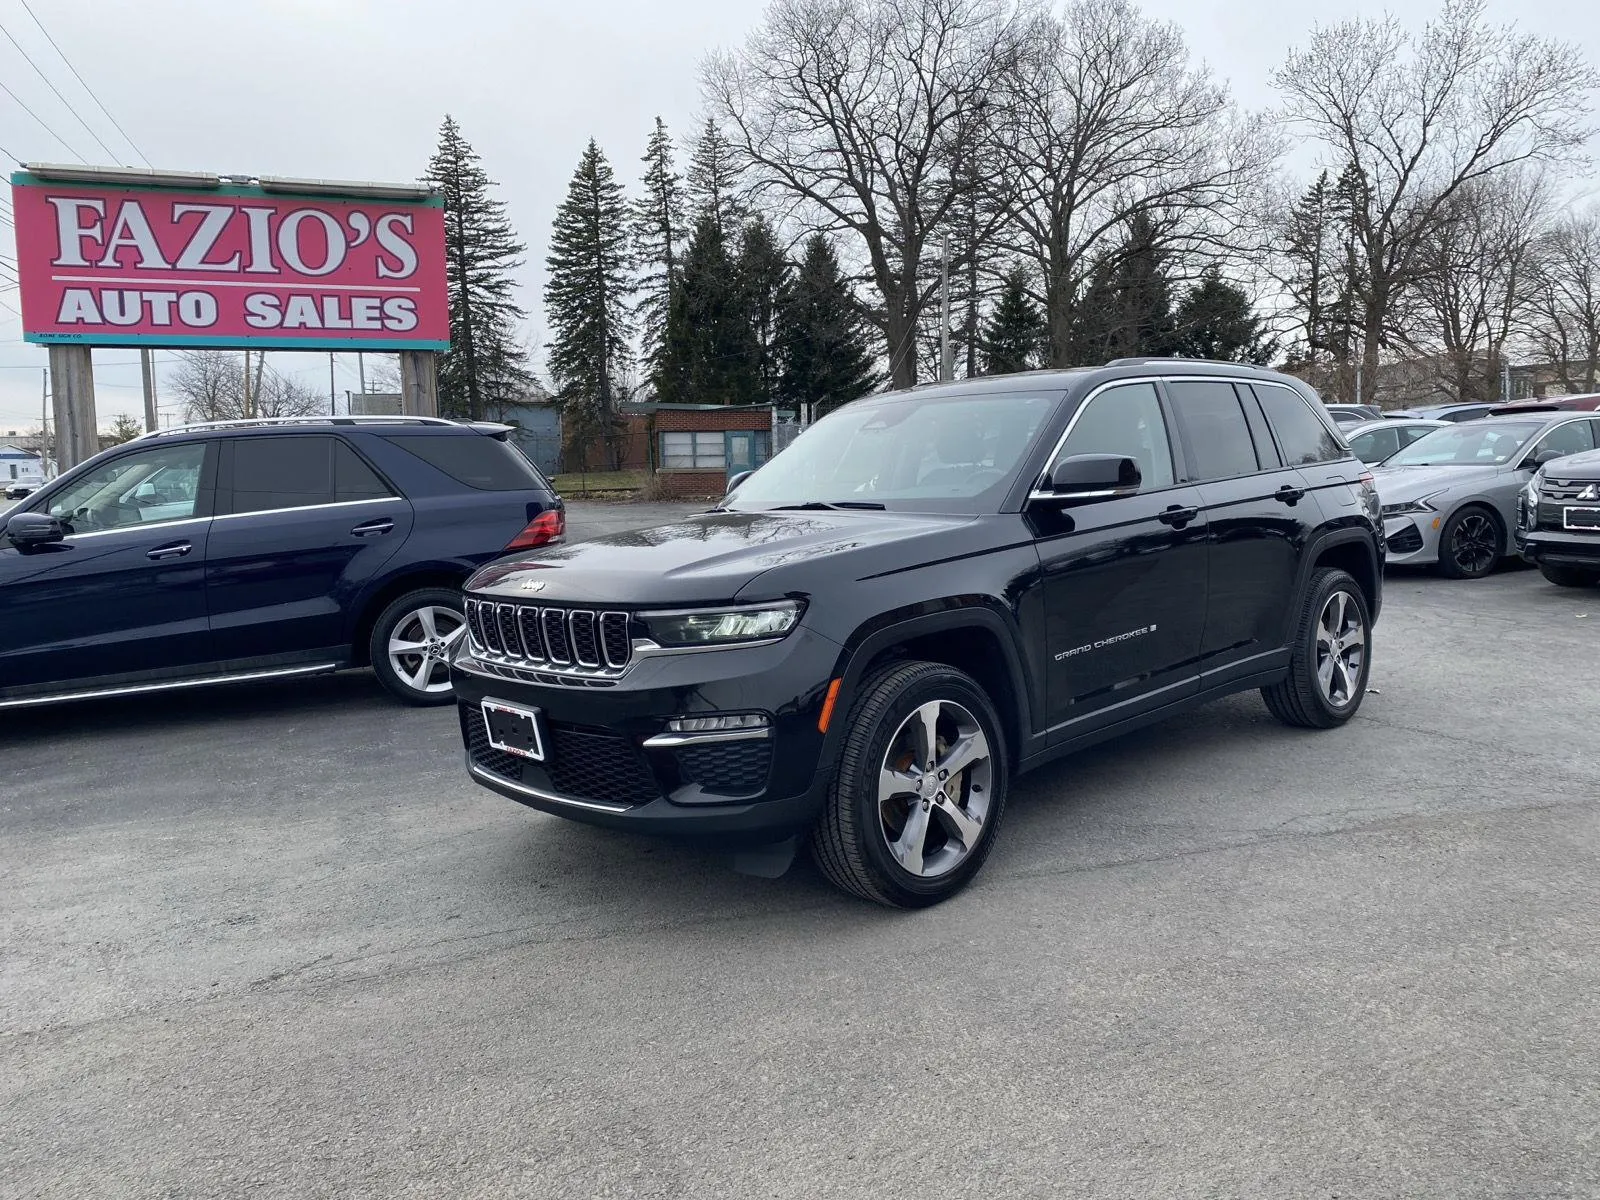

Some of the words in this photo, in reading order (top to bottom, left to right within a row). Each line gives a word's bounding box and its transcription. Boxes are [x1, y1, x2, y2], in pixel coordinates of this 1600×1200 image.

[47, 196, 419, 280] FAZIO'S
[57, 287, 219, 327] AUTO
[244, 292, 419, 332] SALES
[521, 578, 546, 592] Jeep
[1054, 644, 1092, 661] GRAND
[1094, 627, 1148, 648] CHEROKEE
